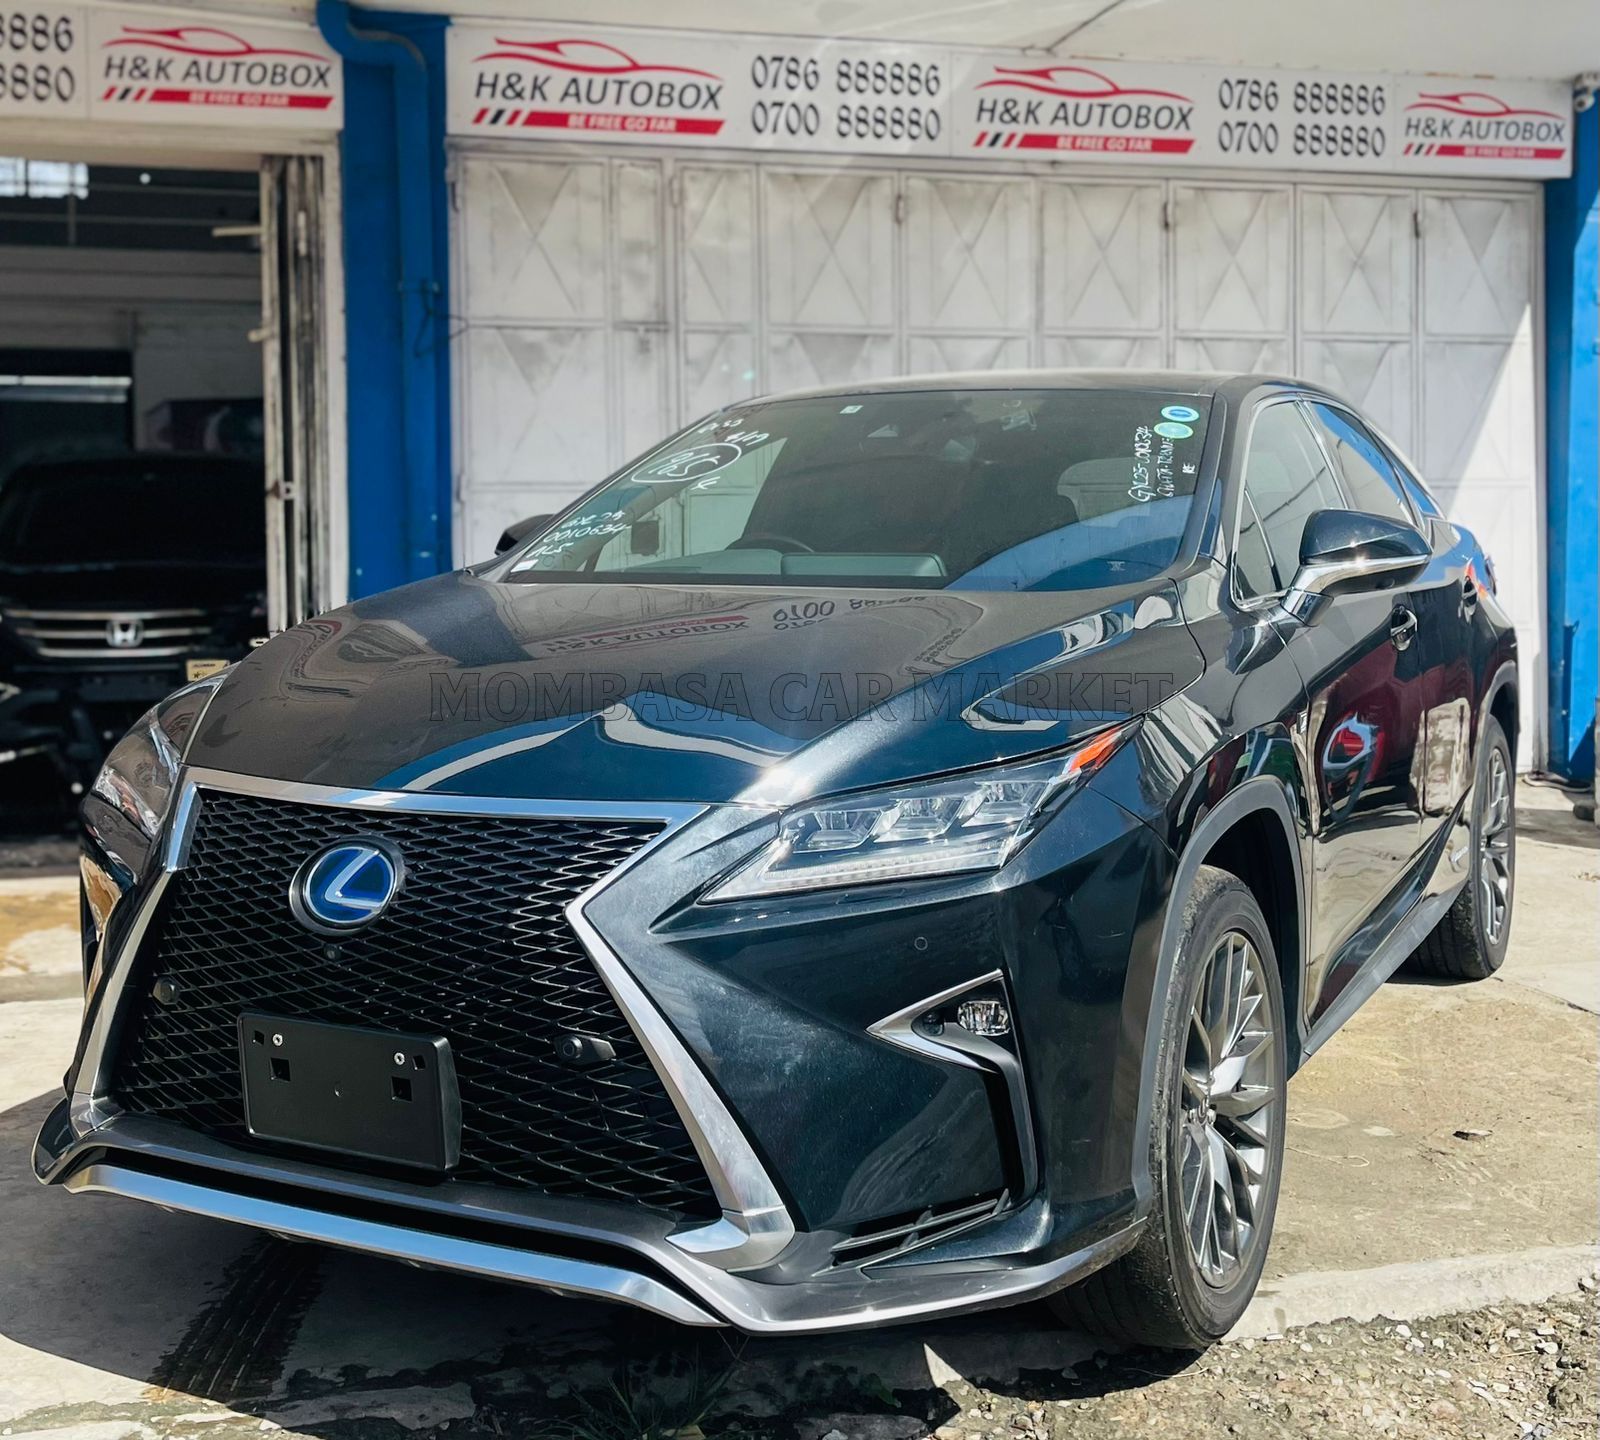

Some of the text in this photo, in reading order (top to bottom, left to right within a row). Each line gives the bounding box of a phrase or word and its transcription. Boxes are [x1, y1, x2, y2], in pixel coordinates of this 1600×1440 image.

[0, 12, 74, 53] 886
[104, 56, 332, 89] H&K AUTOBOX
[475, 71, 723, 111] H&K AUTOBOX
[751, 55, 941, 97] 0786 888886
[976, 98, 1194, 131] H&K AUTOBOX
[1218, 78, 1386, 116] 0786 888886
[568, 113, 677, 133] BE FREE GO FAR
[751, 101, 942, 142] 0700 888880
[1218, 121, 1386, 158] 0700 888880
[1405, 117, 1565, 142] H&K AUTOBOX
[1057, 135, 1152, 152] BE FREE GO FAR
